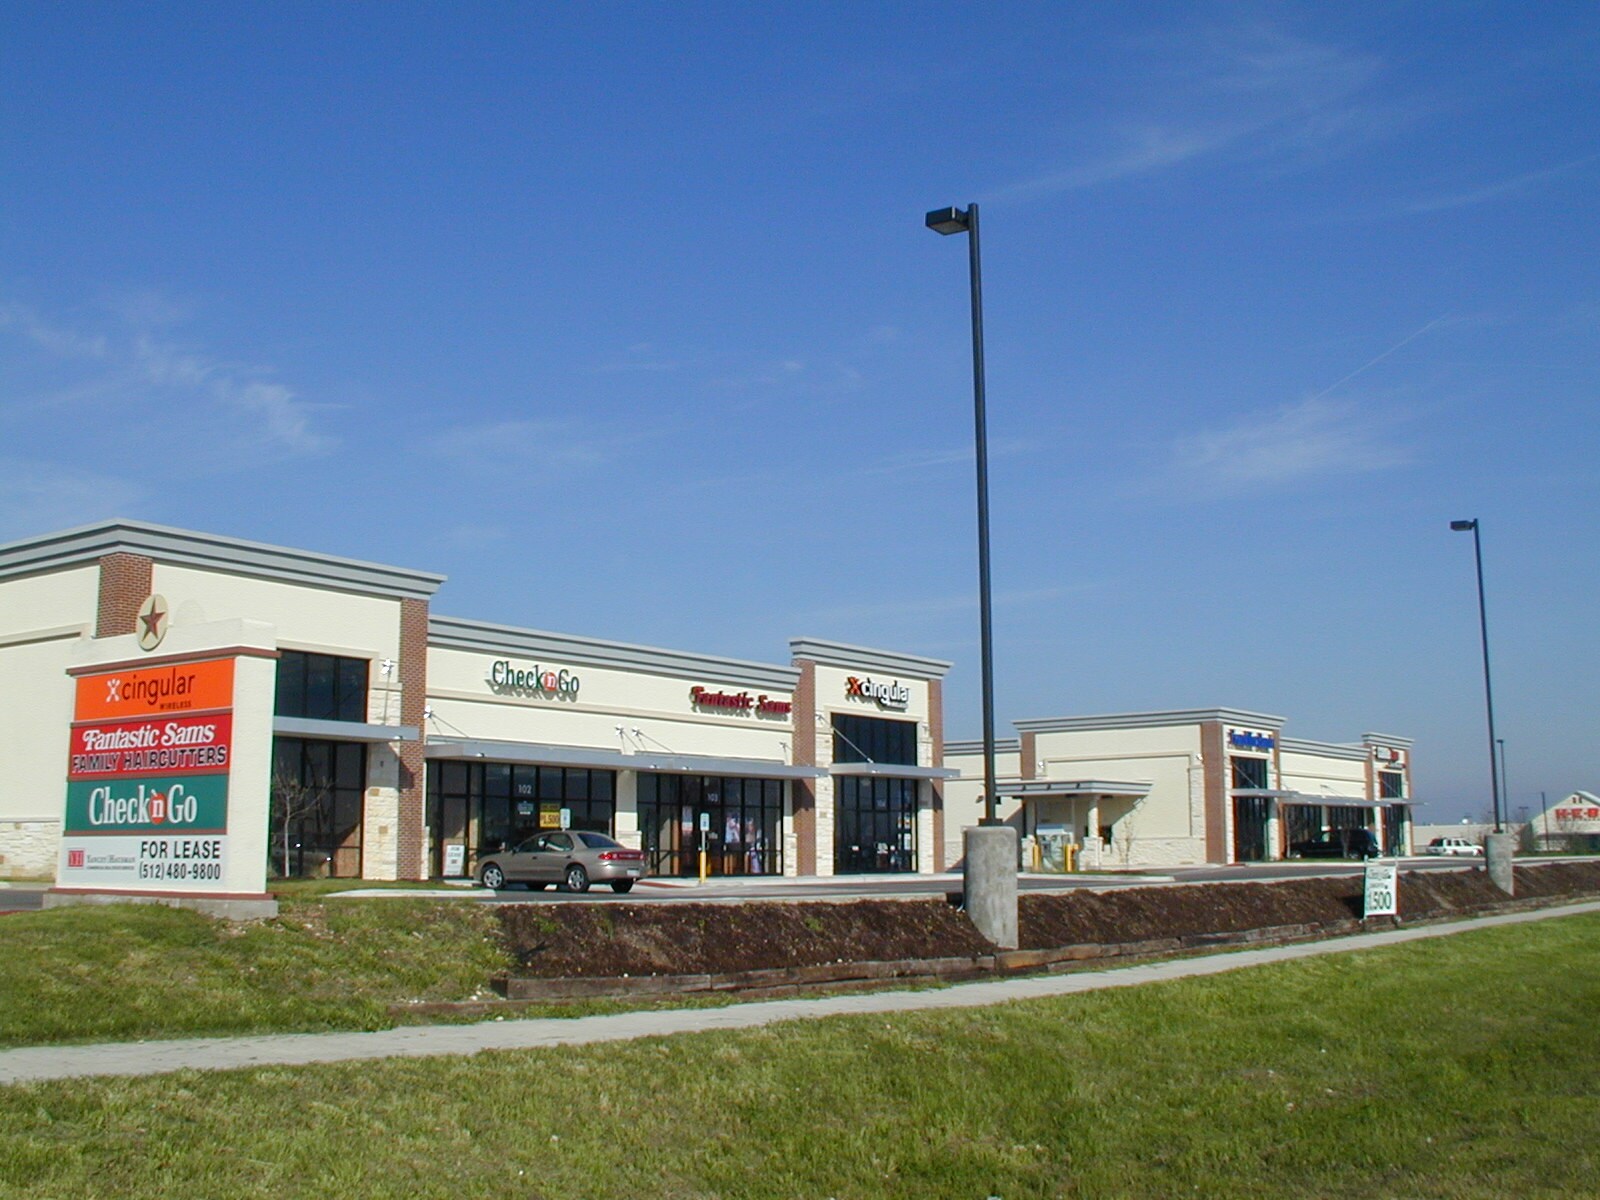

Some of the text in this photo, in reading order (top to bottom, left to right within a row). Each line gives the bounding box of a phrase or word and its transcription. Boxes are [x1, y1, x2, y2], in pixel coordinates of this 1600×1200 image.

[122, 668, 196, 706] cingular
[492, 660, 545, 690] Check
[558, 669, 580, 694] Go
[160, 700, 192, 710] WIRELESS
[689, 686, 792, 714] Fantastic Sams
[82, 722, 217, 751] Fantastic Sams
[71, 744, 228, 774] FAMILY HAIRCUTTERS
[518, 784, 532, 794] 102
[89, 784, 150, 825] Check
[167, 784, 198, 824] Go
[140, 840, 221, 859] FOR LEASE
